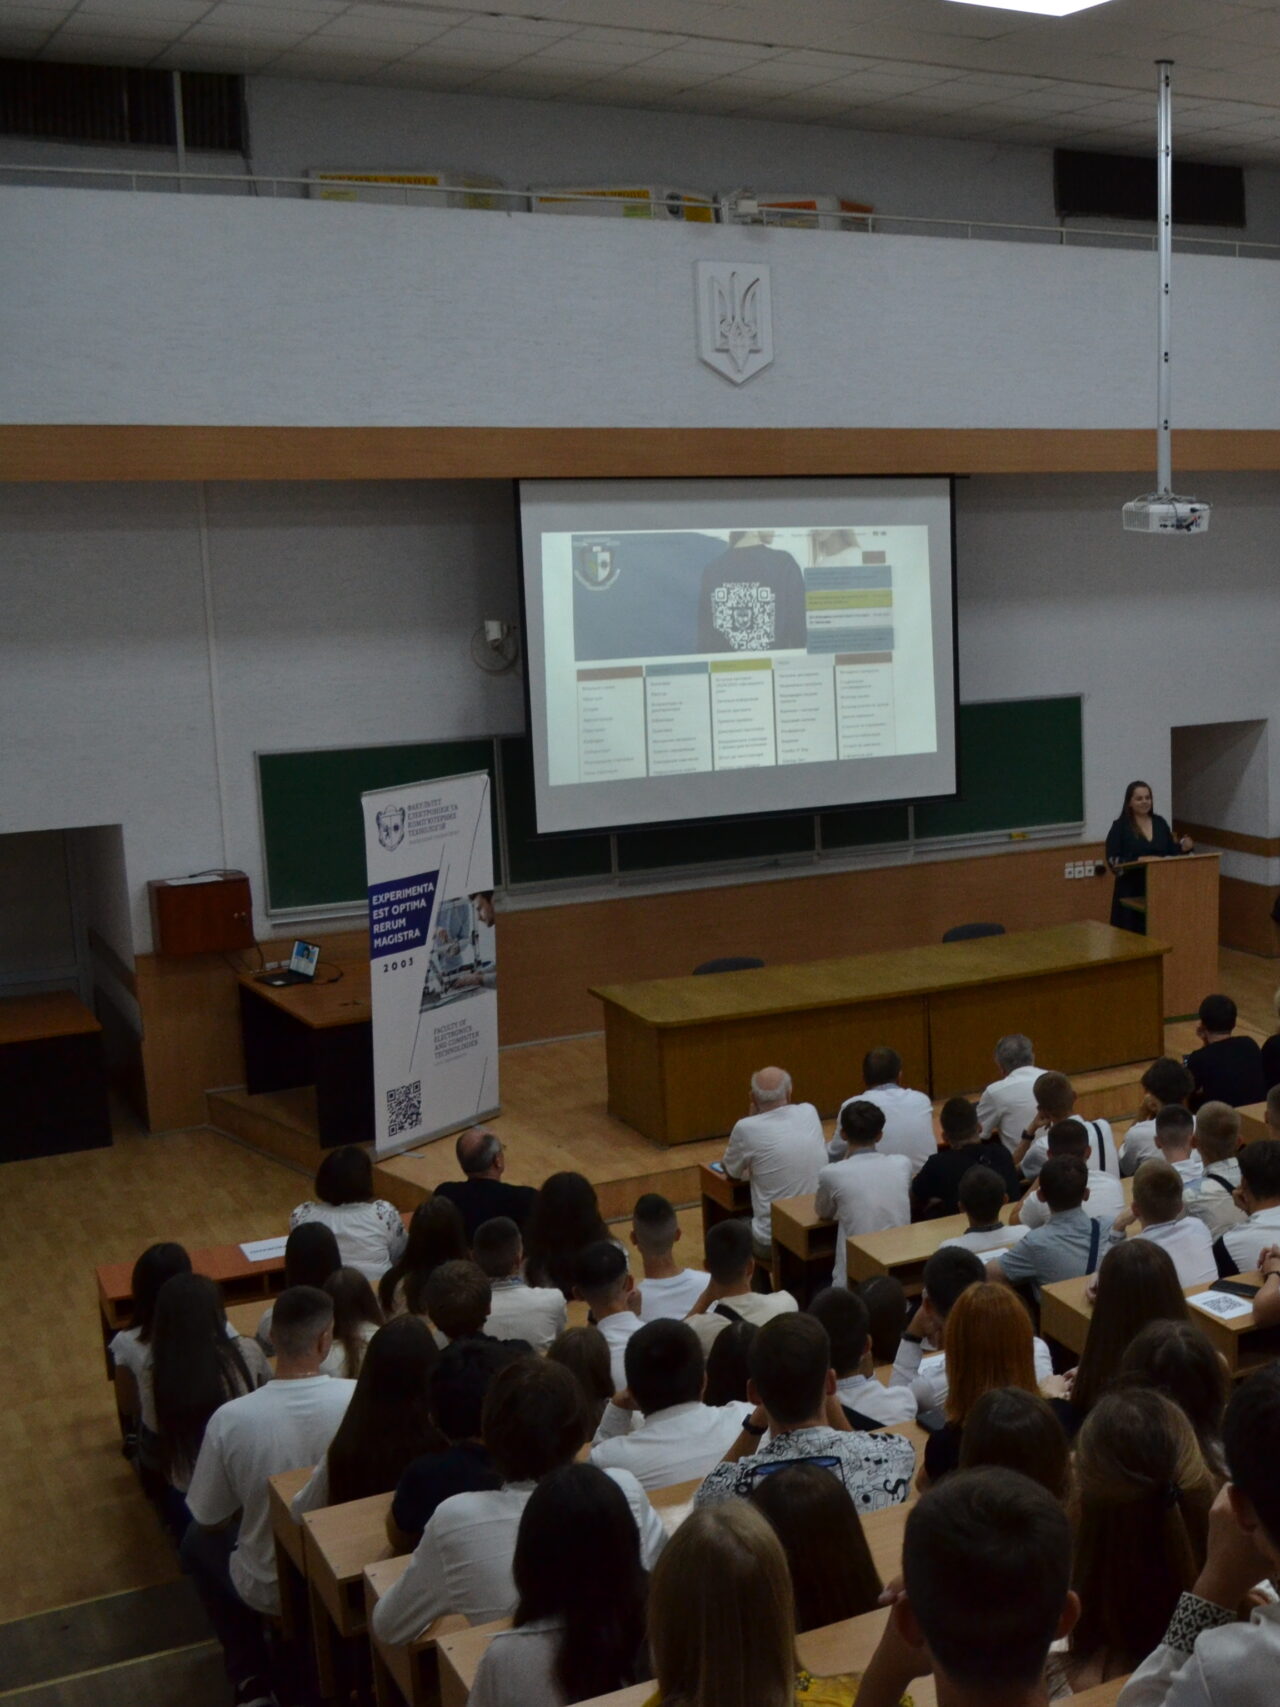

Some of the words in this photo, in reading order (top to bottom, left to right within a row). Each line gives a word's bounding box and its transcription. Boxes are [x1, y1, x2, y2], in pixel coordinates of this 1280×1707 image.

[372, 882, 434, 905] EXPERIMENTA
[373, 907, 389, 920] EST
[391, 898, 427, 916] OPTIMA
[373, 917, 406, 934] RERUM
[374, 928, 421, 948] MAGISTRA
[433, 1021, 458, 1035] FACULTY
[434, 1025, 472, 1043] ELECTRONICS
[434, 1041, 447, 1051] AND
